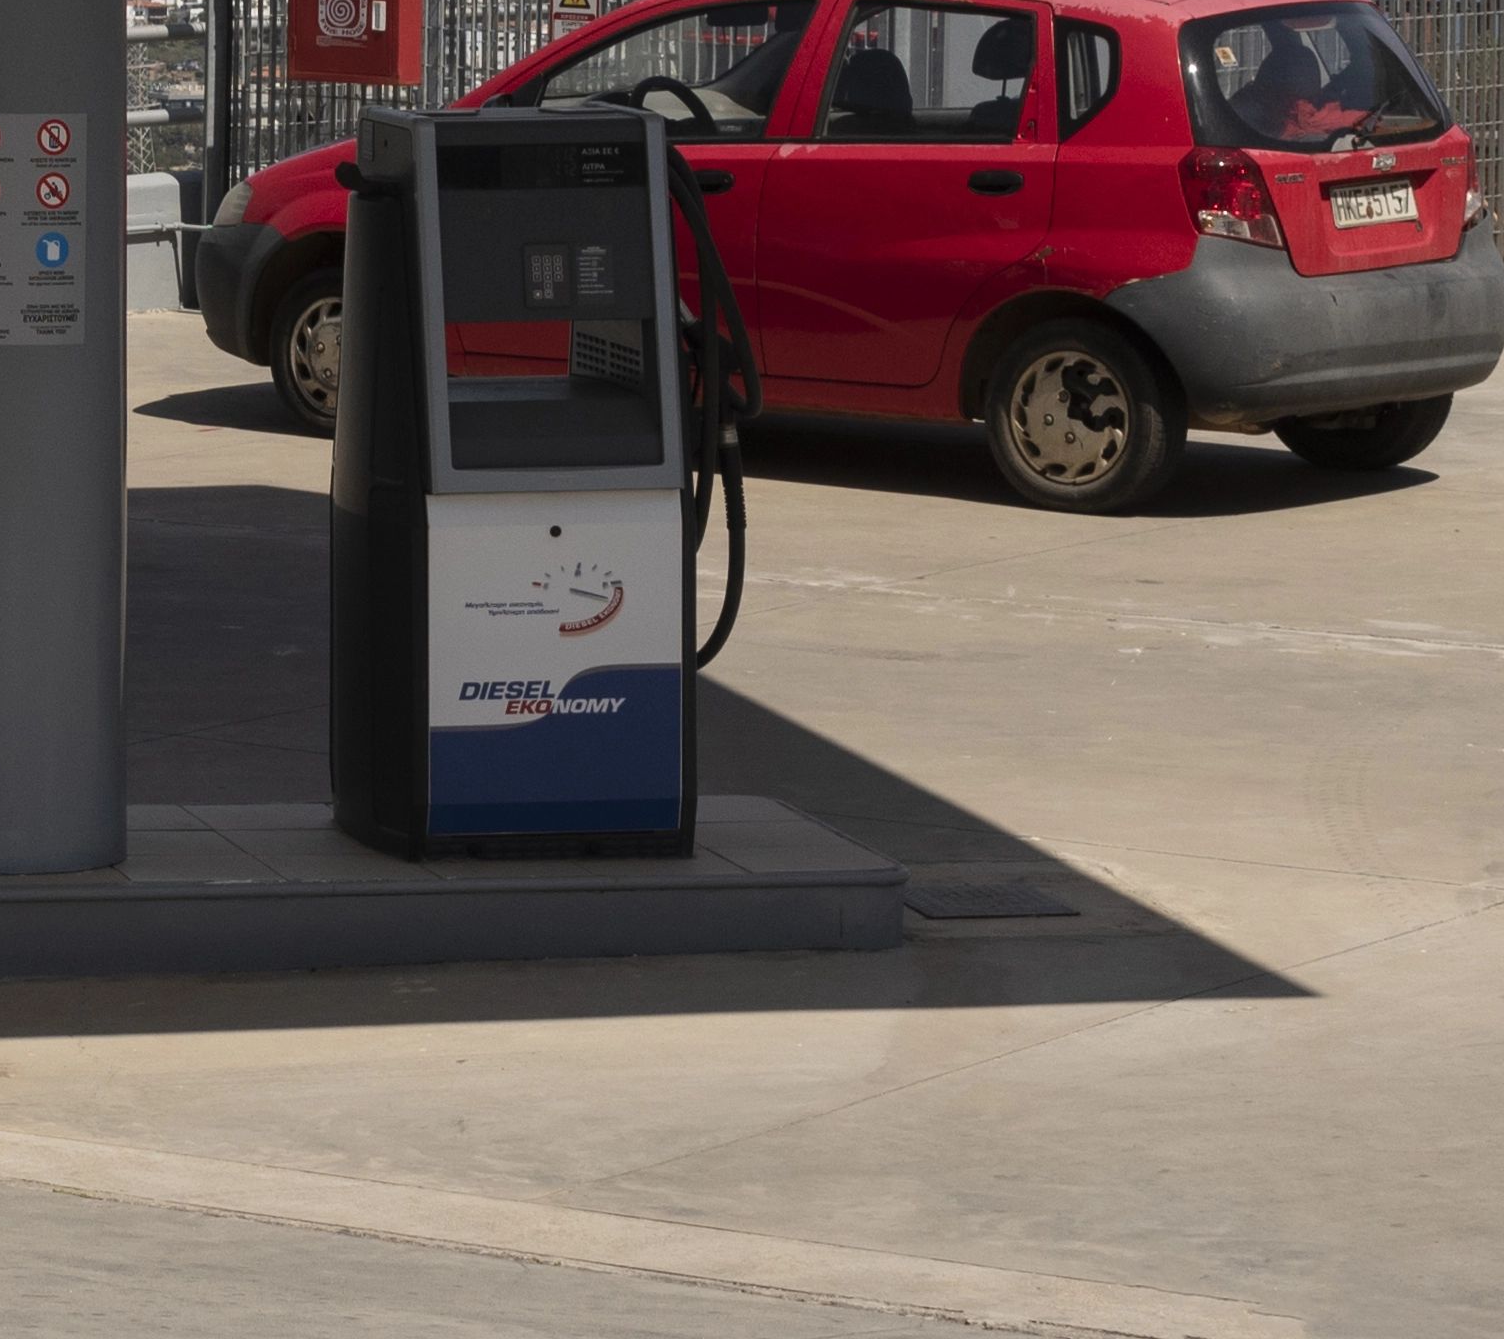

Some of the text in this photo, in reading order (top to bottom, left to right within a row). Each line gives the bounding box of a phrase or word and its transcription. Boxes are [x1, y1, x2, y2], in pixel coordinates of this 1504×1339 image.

[1370, 184, 1409, 217] 5157
[458, 680, 556, 701] DIESEL
[505, 697, 626, 715] EKONOMY
